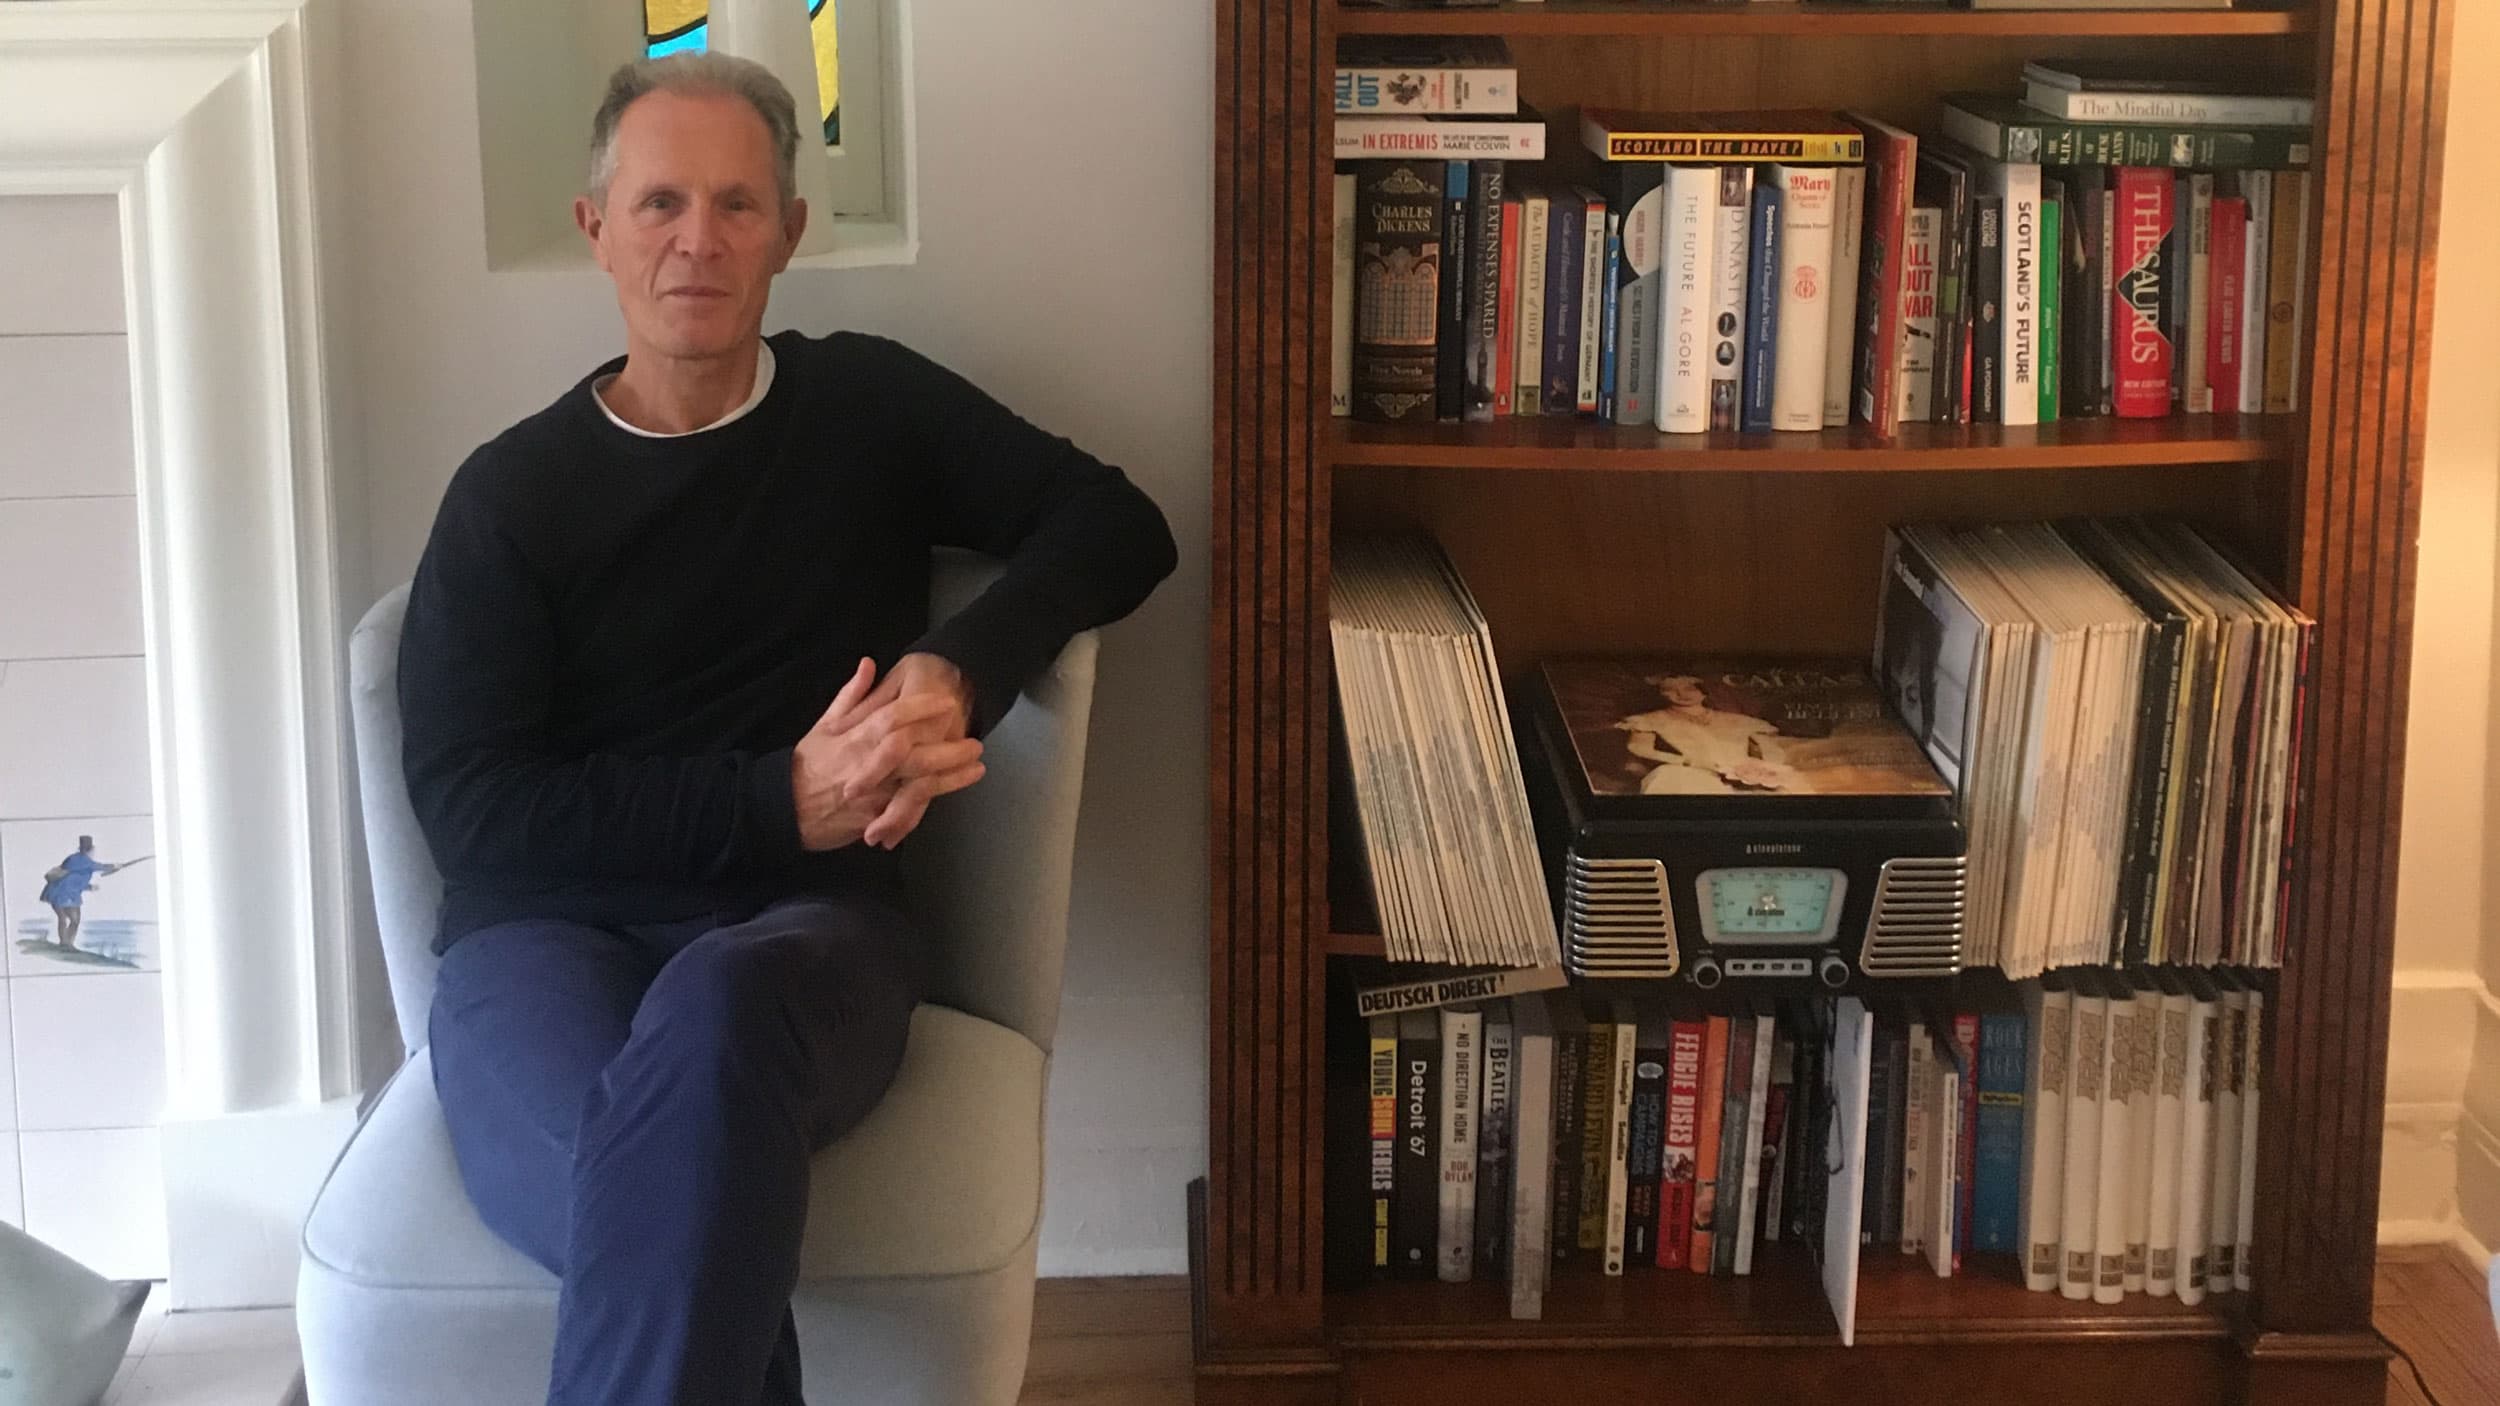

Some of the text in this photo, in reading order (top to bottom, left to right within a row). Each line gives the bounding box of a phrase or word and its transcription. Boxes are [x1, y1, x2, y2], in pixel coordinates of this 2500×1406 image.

[1336, 71, 1352, 109] FALL
[1358, 74, 1379, 107] OUT
[2079, 99, 2208, 120] The Mindful Day
[1363, 133, 1376, 150] IN
[1380, 133, 1438, 150] EXTREMIS
[1443, 142, 1510, 150] MARIE COLVIN
[1614, 140, 1800, 155] SCOTLAND THE BRAVE?
[1790, 175, 1831, 193] Mary
[1372, 203, 1432, 220] CHARLES
[1376, 220, 1431, 233] DICKENS
[1765, 205, 1776, 247] Speeches
[1482, 173, 1501, 338] NO EXPENSES SPARED
[1528, 224, 1543, 291] AUDACITY
[1726, 209, 1745, 312] DYNASTY
[1677, 195, 1698, 377] THE FUTURE AL GORE
[2015, 200, 2032, 385] SCOTLAND'S FUTURE
[2131, 185, 2162, 364] THESAURUS
[1528, 297, 1540, 311] of
[1583, 240, 1599, 383] THE SHORTEST HISTORY OF GERMANY
[1526, 312, 1539, 349] HOPE
[1760, 316, 1770, 342] World
[2220, 335, 2232, 364] NEWS
[1361, 986, 1434, 1013] DEUTSCH
[1374, 1049, 1393, 1097] YOUNG
[1453, 1032, 1470, 1144] NO DIRECTION HOME
[1490, 1047, 1509, 1113] BEATLES
[1669, 1032, 1700, 1144] FERGIE RISES
[1411, 1060, 1427, 1129] Detroit
[1373, 1099, 1393, 1136] SOUL
[1372, 1139, 1393, 1190] REBELS
[1445, 1171, 1474, 1183] DYLAN
